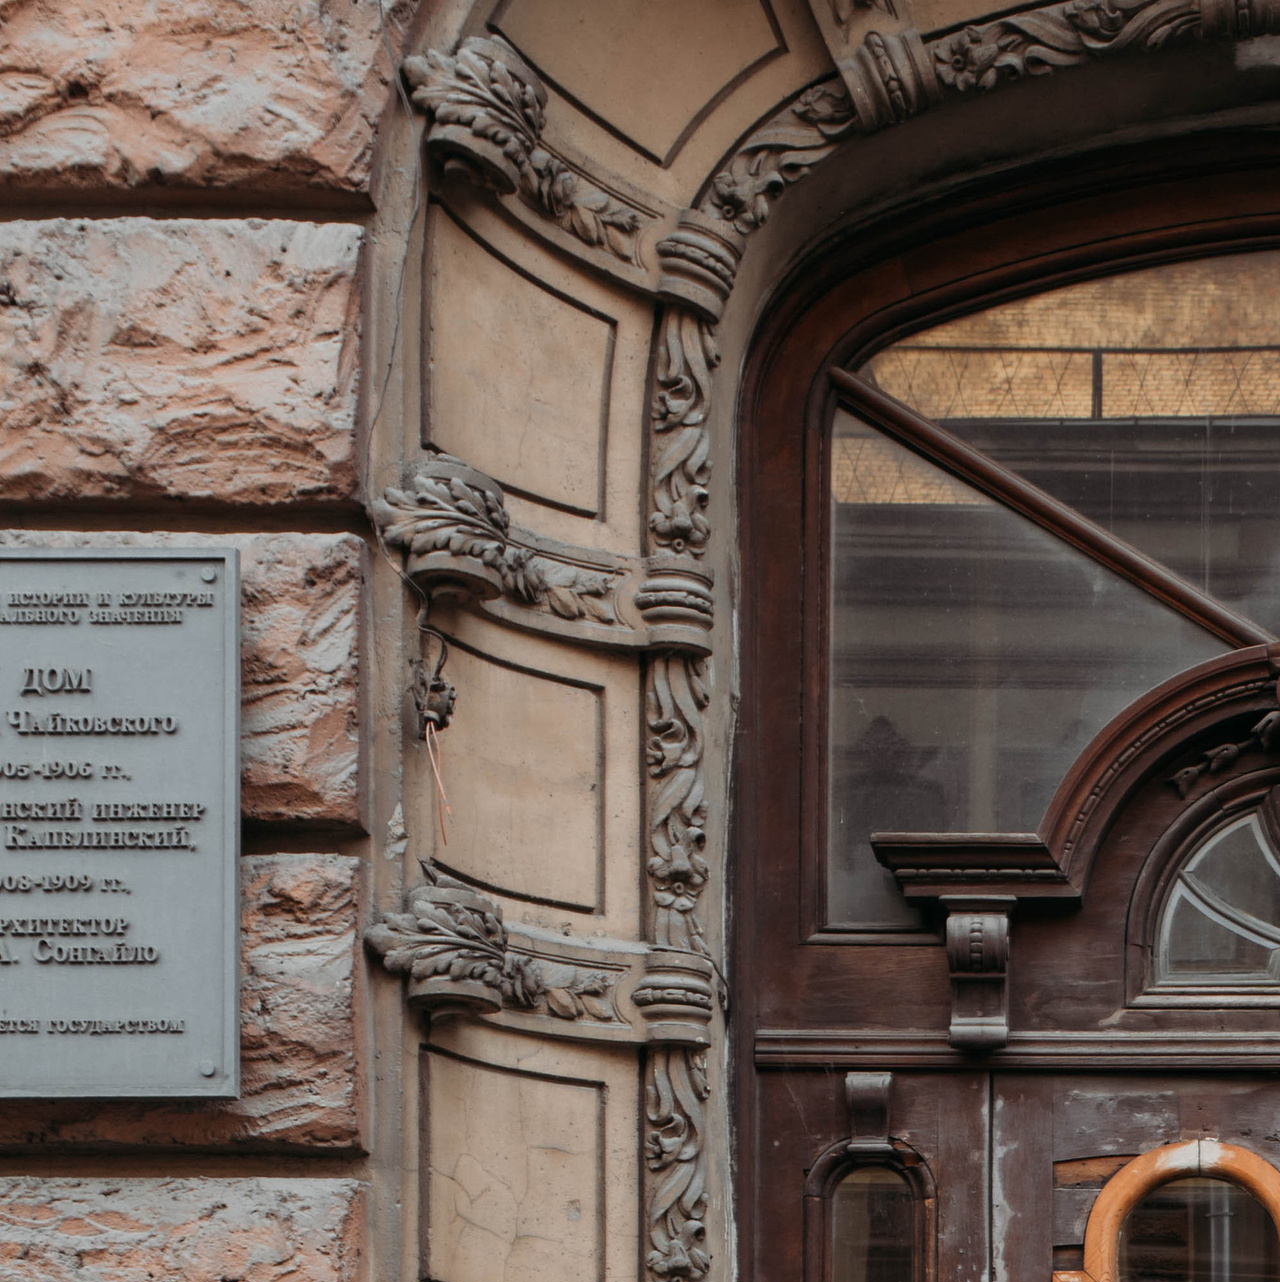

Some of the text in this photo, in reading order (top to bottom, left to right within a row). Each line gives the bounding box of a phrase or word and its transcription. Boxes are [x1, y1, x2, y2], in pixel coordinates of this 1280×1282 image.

[8, 591, 214, 607] ИСТОРИИ И КУЛЬТУРЫ
[89, 609, 183, 624] ЗНАЧЕНИЯ
[20, 668, 92, 697] ДОМ
[0, 760, 92, 779] 05-1906
[92, 802, 206, 820] ИНЖЕНЕР
[0, 873, 93, 893] 08-1909
[47, 1018, 185, 1036] ГОСУДАРСТВОМ
